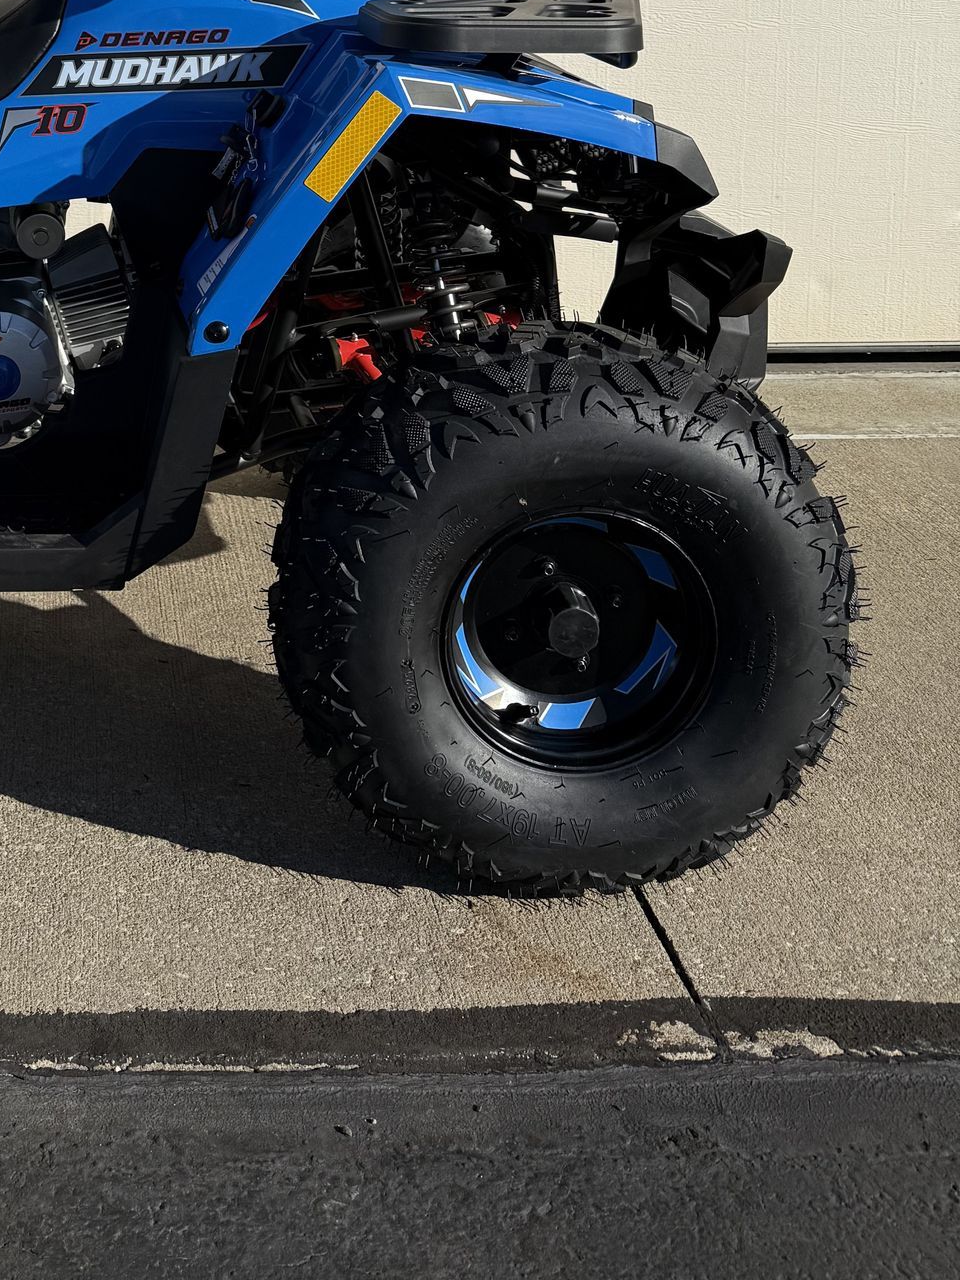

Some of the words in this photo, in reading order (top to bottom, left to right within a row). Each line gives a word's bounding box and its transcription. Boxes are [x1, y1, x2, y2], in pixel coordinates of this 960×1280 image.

[99, 28, 231, 48] DENAGO
[52, 51, 273, 89] MUDHAWK
[32, 104, 87, 136] 10
[423, 752, 540, 841] 19x7.00-8
[548, 815, 592, 847] AT
